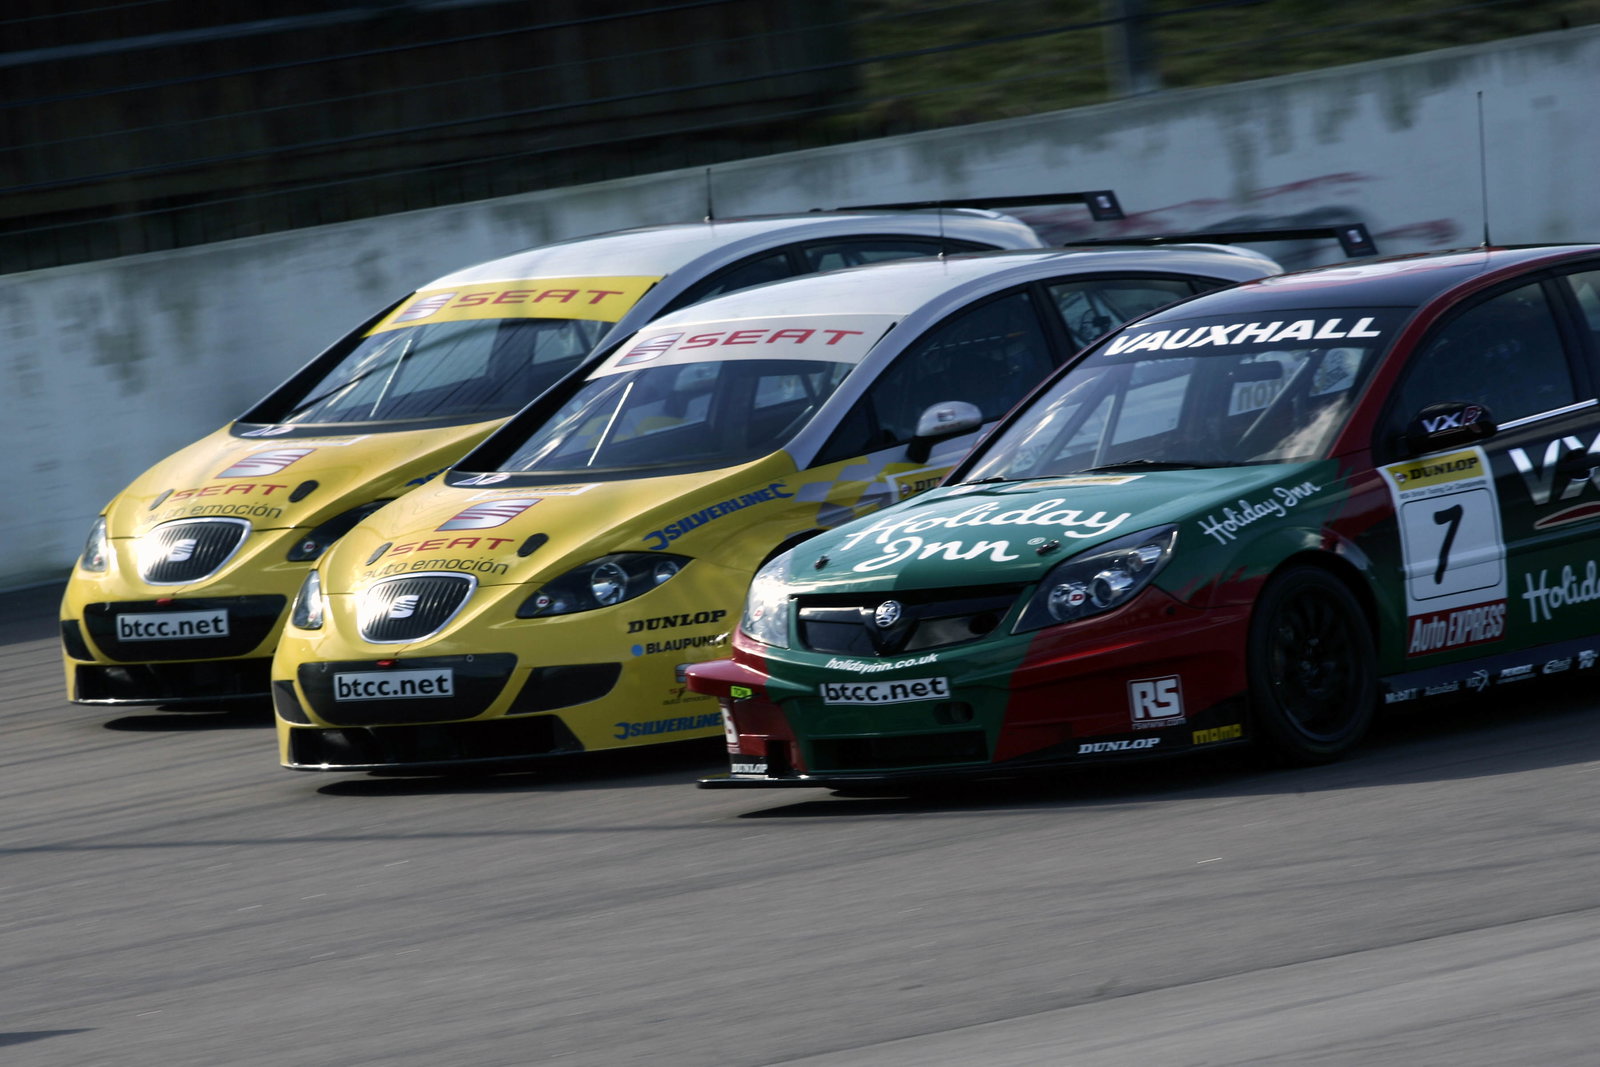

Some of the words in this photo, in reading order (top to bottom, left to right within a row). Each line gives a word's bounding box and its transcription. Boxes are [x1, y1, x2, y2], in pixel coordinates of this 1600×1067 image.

[451, 290, 624, 309] SEAT
[678, 329, 864, 351] SEAT
[1104, 317, 1381, 357] VAUXHALL
[1408, 457, 1478, 480] DUNLOP
[170, 484, 288, 502] SEAT
[1201, 494, 1286, 545] Holiday
[1281, 481, 1321, 507] Inn
[840, 499, 1133, 552] Holiday
[386, 537, 515, 557] SEAT
[853, 536, 1020, 573] Inn
[1433, 504, 1464, 584] 7
[412, 558, 509, 576] emoción
[121, 615, 224, 638] btcc.net
[628, 610, 726, 634] DUNLOP
[1409, 618, 1448, 654] Auto
[1447, 602, 1506, 647] EXPRESS
[825, 653, 938, 674] holidayinn.co.uk
[337, 674, 451, 698] btcc.net
[825, 677, 945, 702] btcc.net
[1131, 679, 1180, 719] RS
[1078, 738, 1160, 753] DUNLOP
[731, 763, 768, 774] DUNLOP
